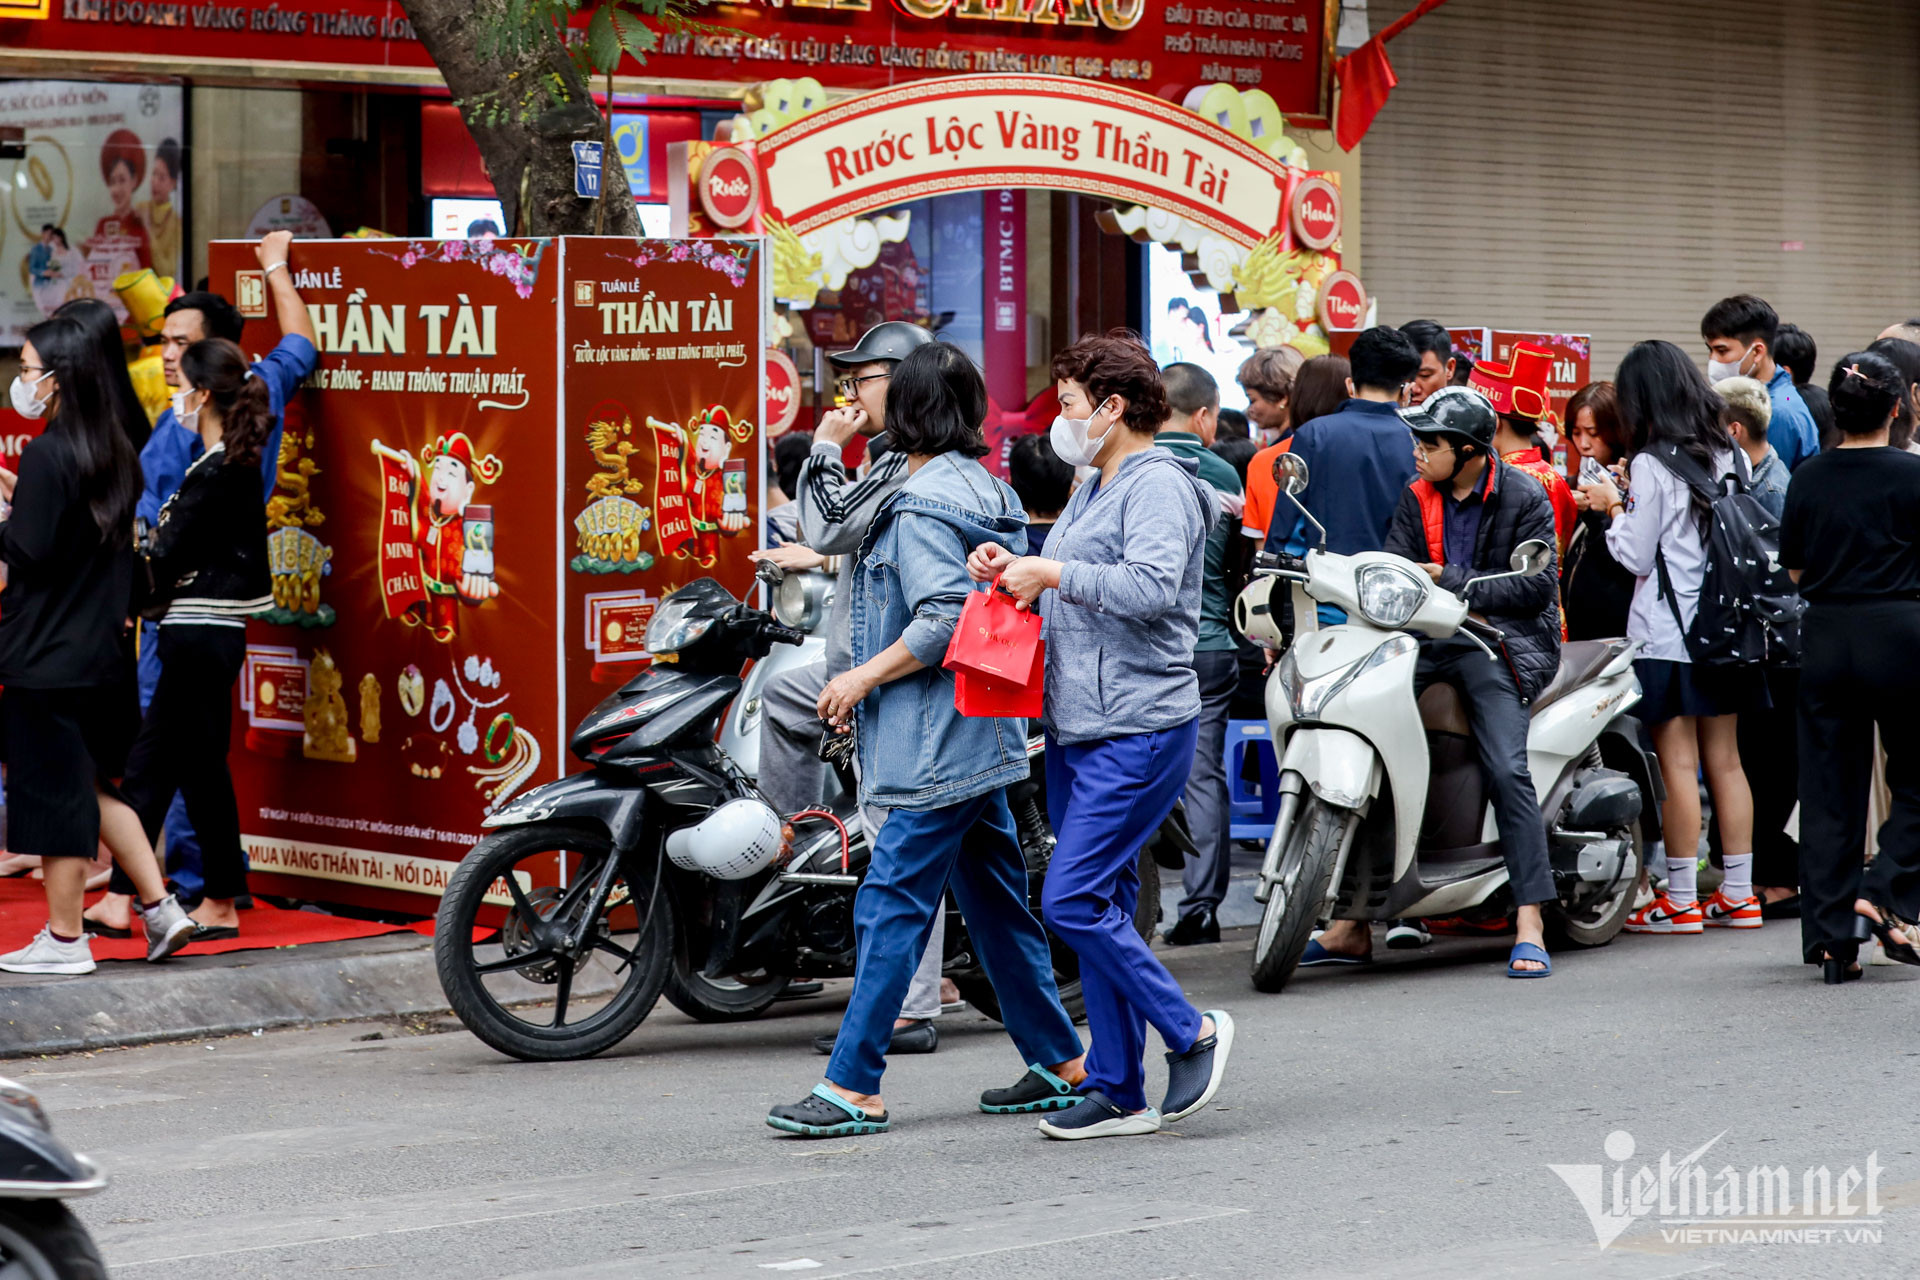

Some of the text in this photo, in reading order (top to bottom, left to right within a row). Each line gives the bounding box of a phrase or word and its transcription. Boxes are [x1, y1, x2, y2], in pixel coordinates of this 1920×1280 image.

[114, 1, 187, 26] DOANH
[192, 2, 246, 29] VÀNG
[381, 16, 418, 40] LON
[1030, 53, 1073, 76] LONG
[825, 110, 1230, 205] Rước Lộc Vàng Thần Tài
[587, 173, 597, 190] 17
[1000, 220, 1014, 291] BTMC
[306, 288, 497, 355] HẦN TÀI
[597, 290, 734, 335] THẦN TÀI
[407, 366, 447, 393] THÔNG
[449, 367, 490, 399] THUẬN
[1553, 357, 1576, 383] TÀI
[388, 474, 410, 497] BẢO
[660, 494, 684, 511] MINH
[661, 516, 689, 539] CHÂU
[385, 542, 414, 560] MINH
[386, 571, 420, 596] CHÂU
[248, 845, 279, 865] MUA
[281, 845, 319, 871] VÀNG
[321, 851, 359, 876] THẦN
[362, 856, 383, 879] TÀI
[394, 860, 420, 884] NỐI
[423, 865, 447, 888] DÀI
